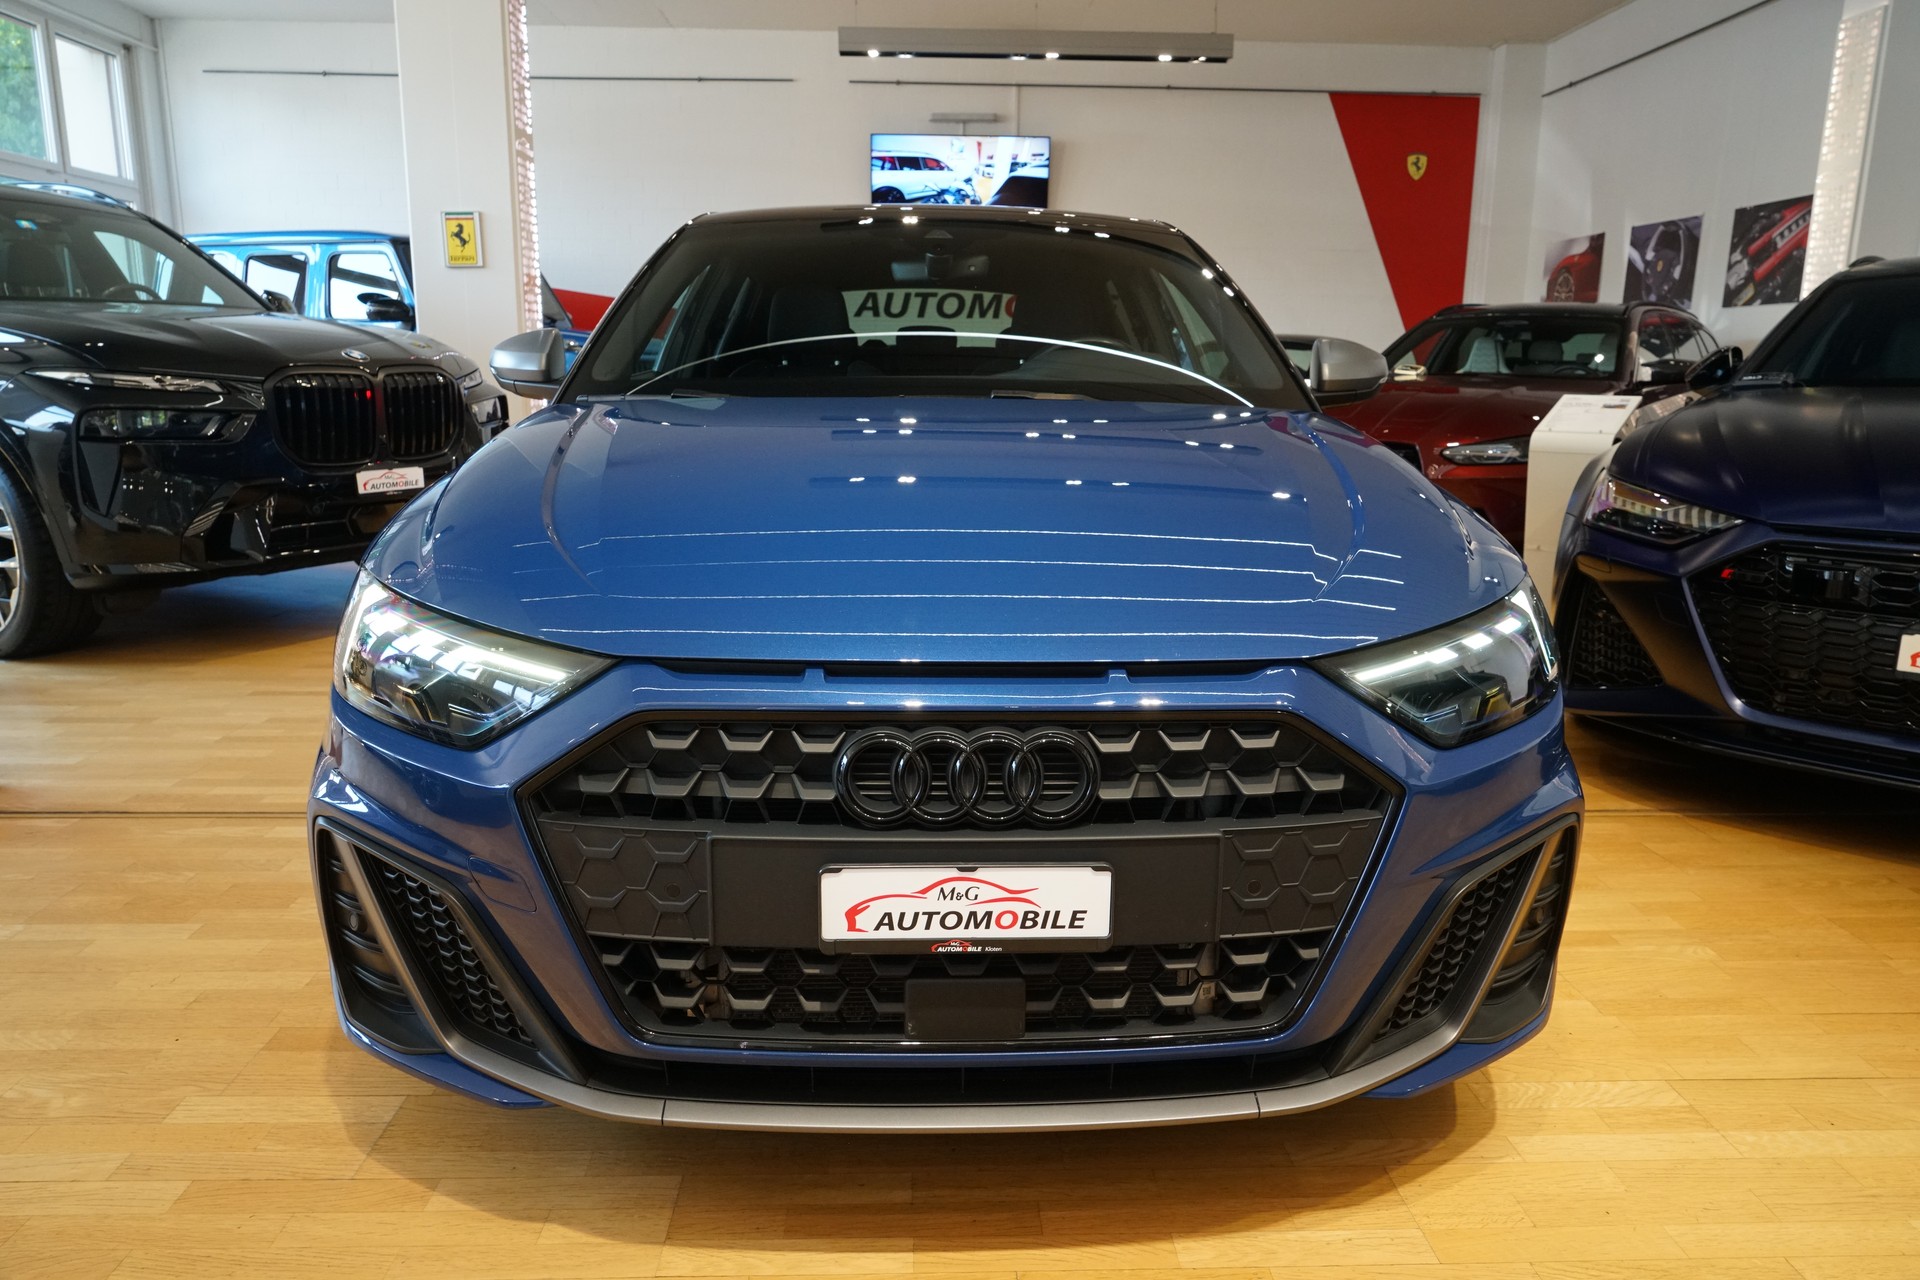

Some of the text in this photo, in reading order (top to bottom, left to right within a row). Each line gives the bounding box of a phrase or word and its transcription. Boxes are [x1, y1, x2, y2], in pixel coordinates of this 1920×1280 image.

[370, 479, 419, 490] AUTOMOBILE
[936, 886, 980, 902] M&G
[873, 909, 1088, 932] AUTOMOBILE
